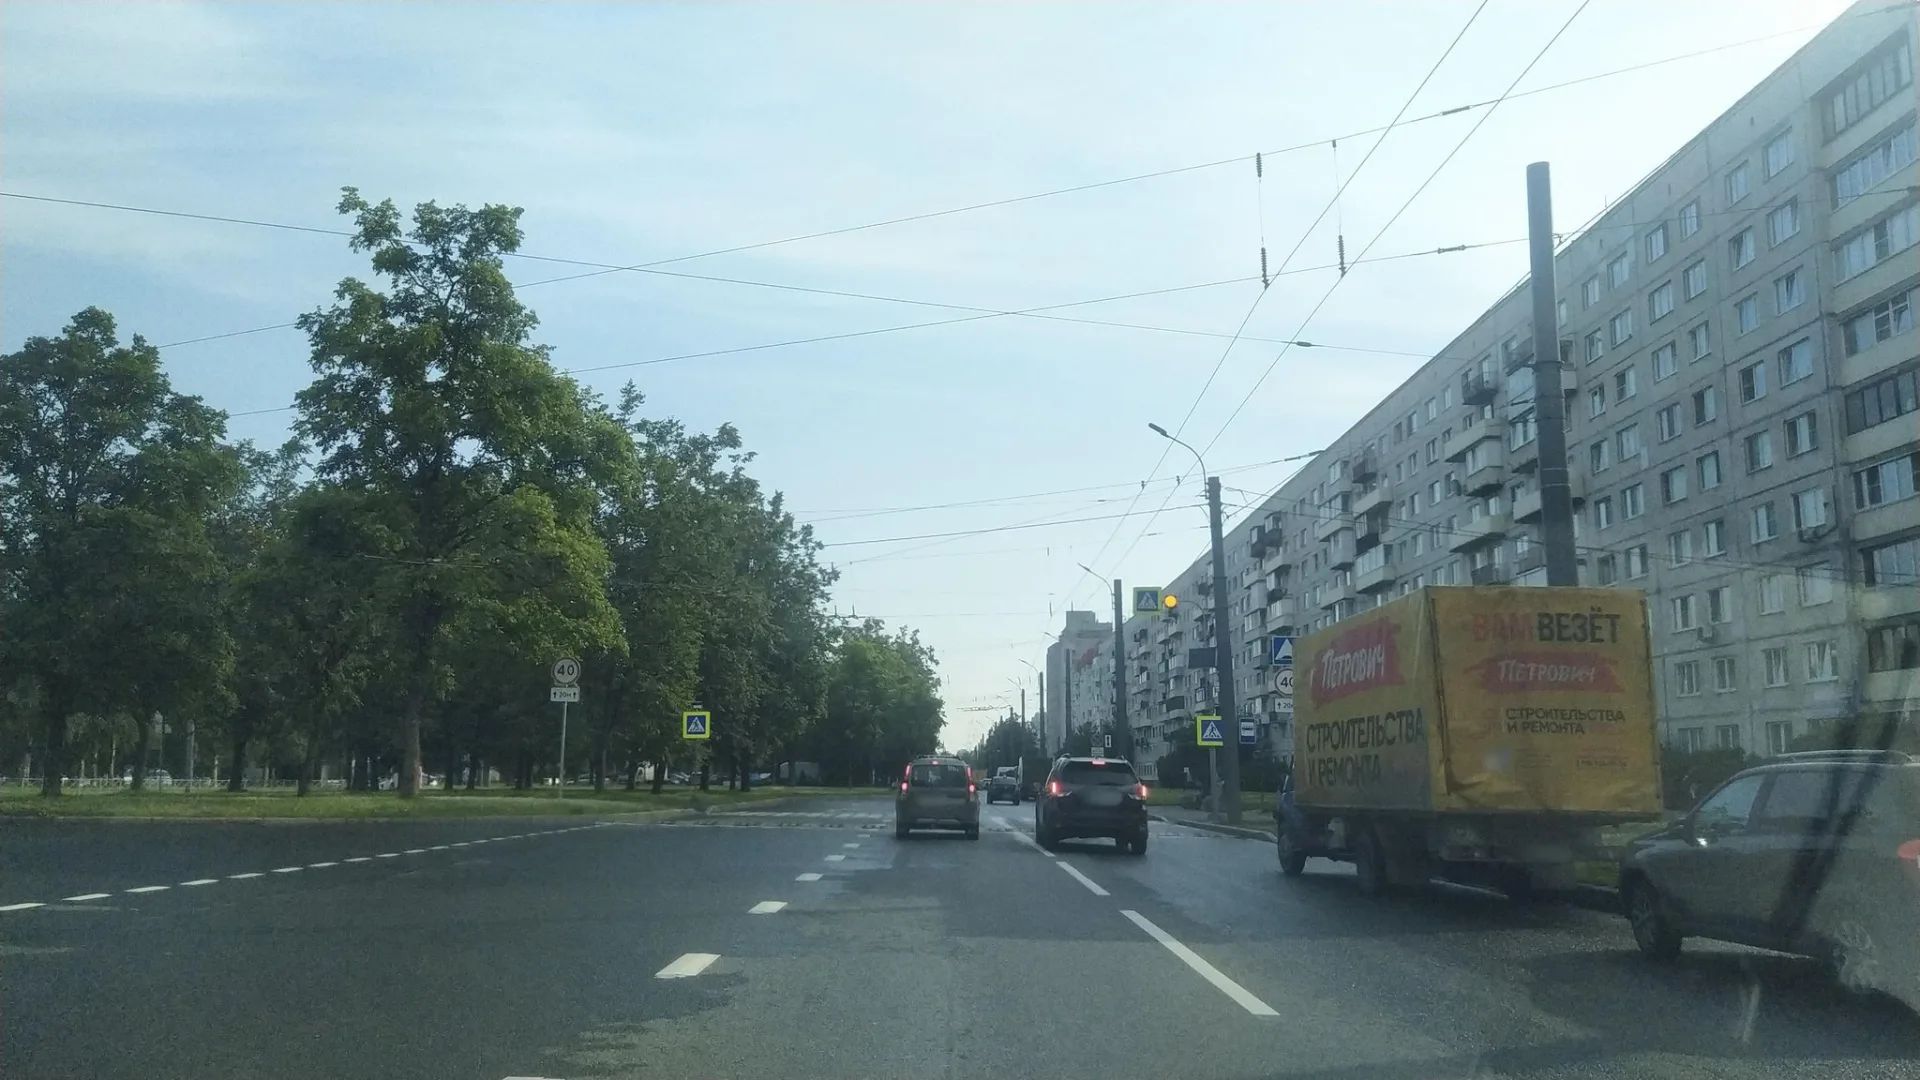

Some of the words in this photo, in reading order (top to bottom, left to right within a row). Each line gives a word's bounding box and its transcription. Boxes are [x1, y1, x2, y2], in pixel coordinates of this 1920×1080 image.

[1537, 606, 1621, 643] ВЕЗЁТ
[557, 664, 575, 676] 40
[1506, 707, 1626, 722] СТРОИТЕЛЬСТВА
[1306, 707, 1425, 753] СТРОИТЕЛЬСТВА
[1507, 721, 1518, 733] И
[1522, 721, 1586, 735] РЕМОНТА
[1318, 754, 1382, 788] РЕМОНТА
